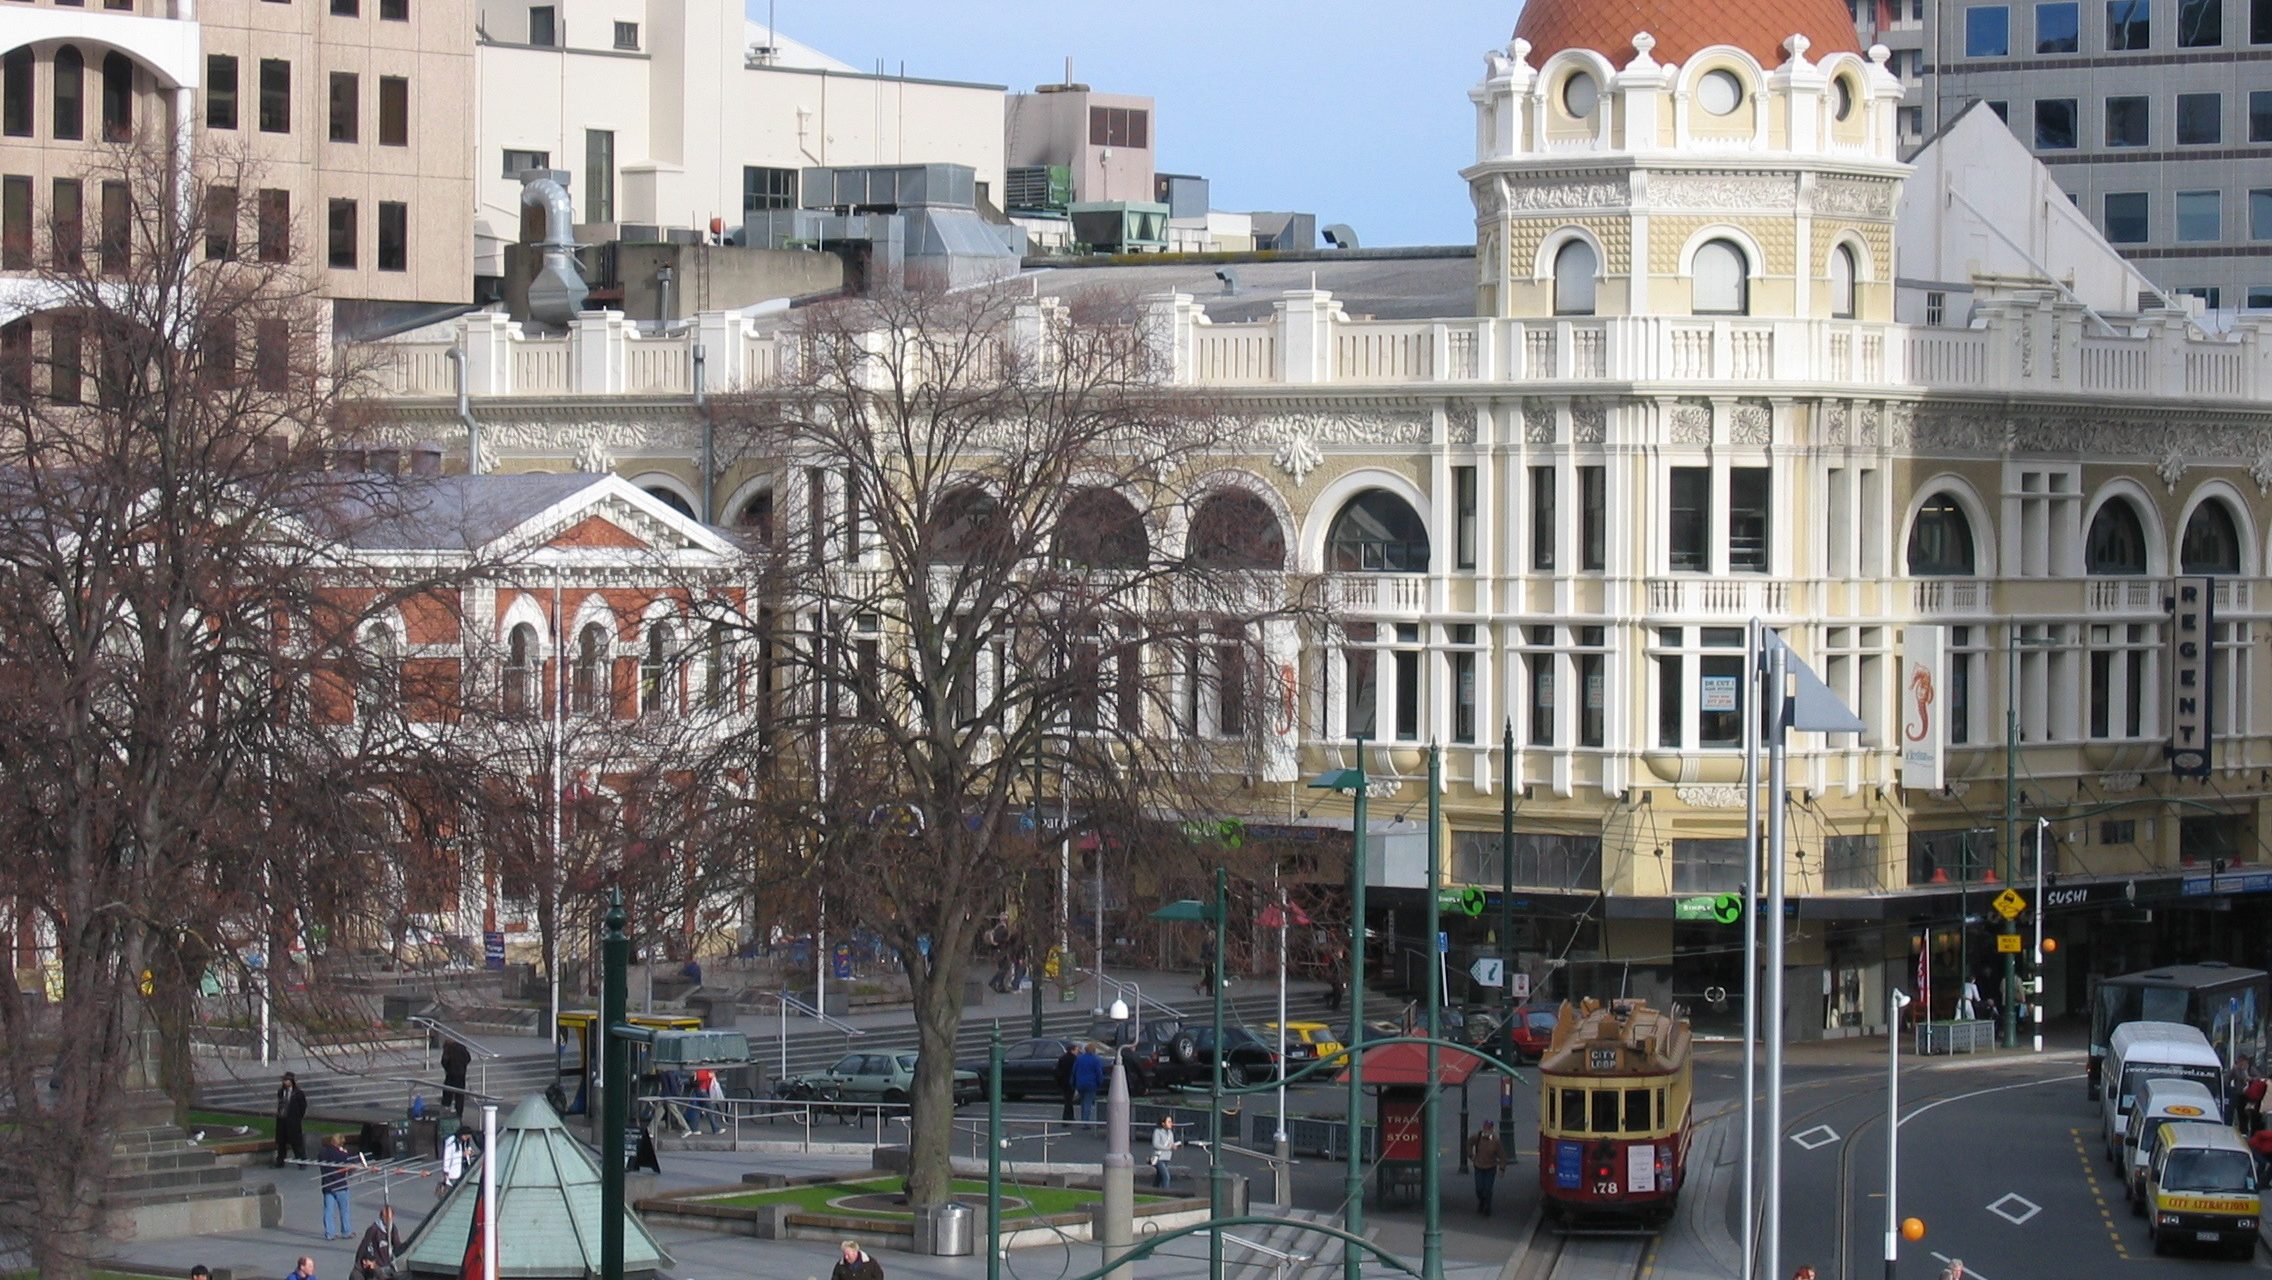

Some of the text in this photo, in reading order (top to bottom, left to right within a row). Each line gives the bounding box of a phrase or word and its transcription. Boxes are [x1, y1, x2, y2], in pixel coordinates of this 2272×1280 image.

[2179, 586, 2198, 744] REGENT
[2047, 889, 2088, 906] SUSHI
[1683, 904, 1712, 912] SIMPLY
[1591, 1050, 1616, 1060] CITY
[1591, 1060, 1617, 1069] LOOP
[1387, 1116, 1419, 1124] TRAM
[1387, 1134, 1419, 1142] STOP
[2168, 1198, 2250, 1210] CITY ATTRACTIONS
